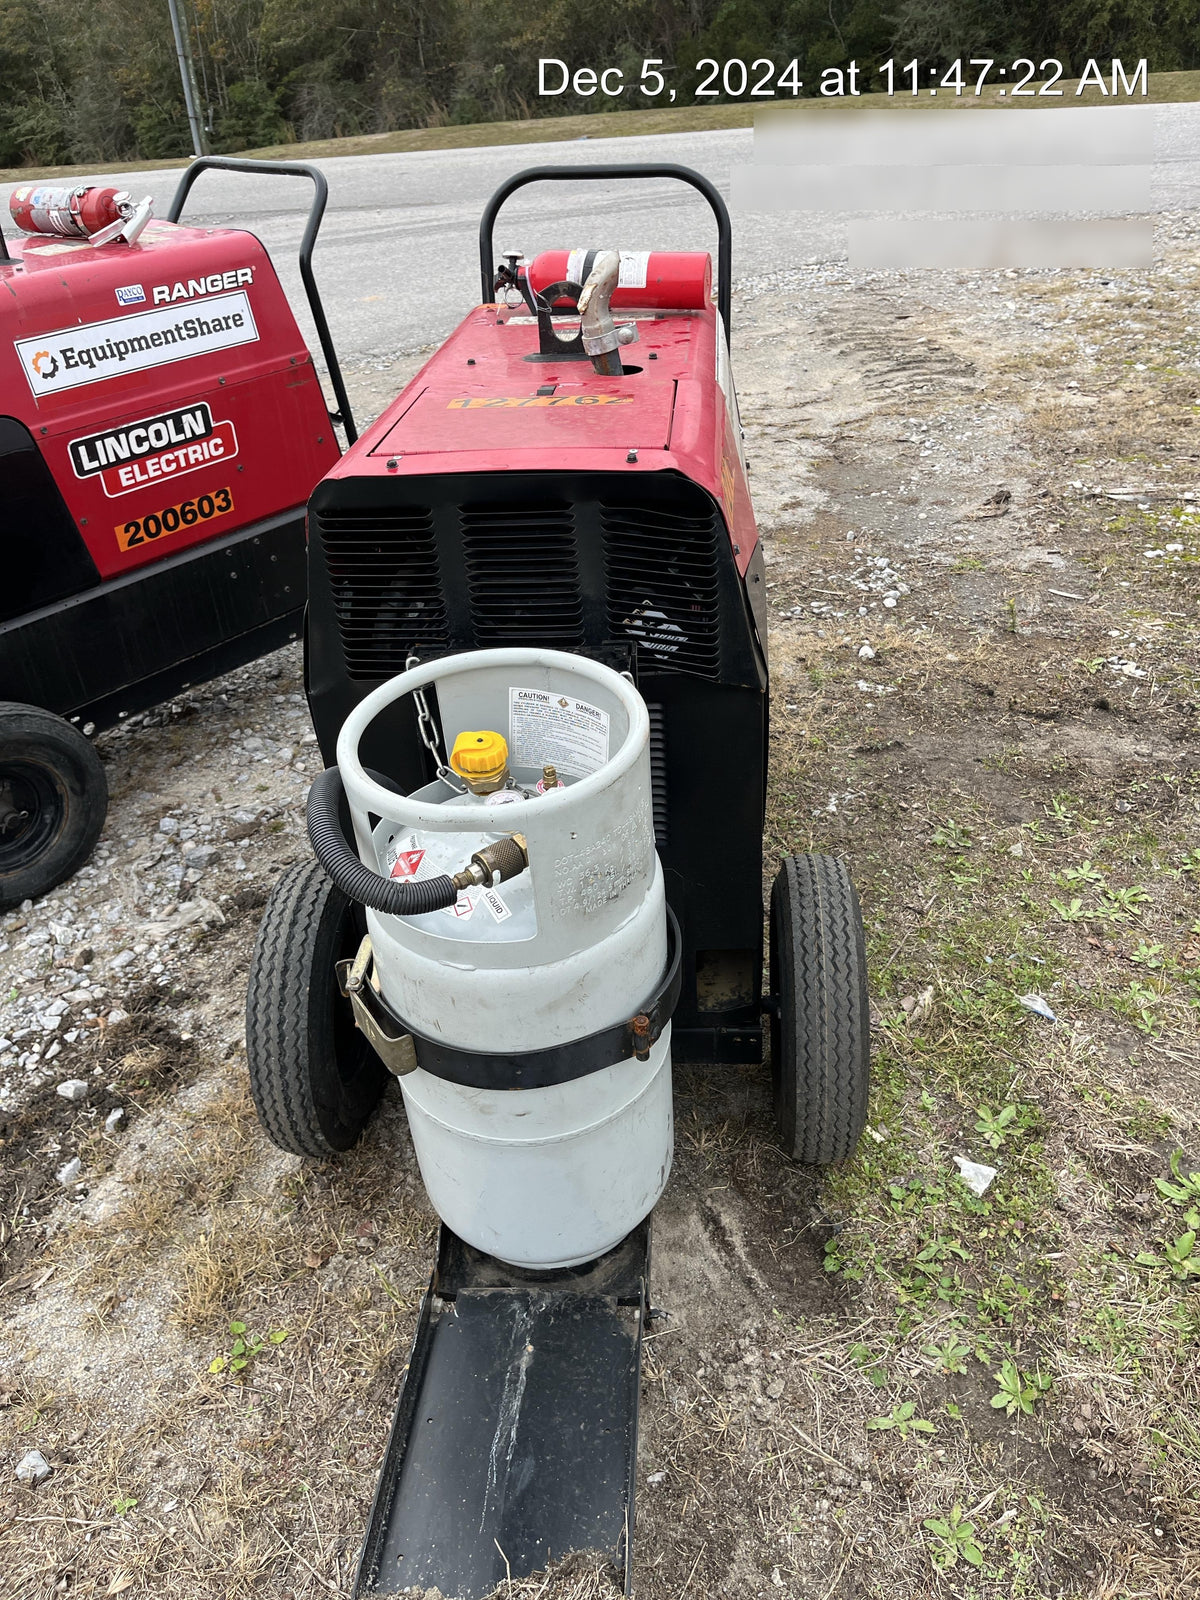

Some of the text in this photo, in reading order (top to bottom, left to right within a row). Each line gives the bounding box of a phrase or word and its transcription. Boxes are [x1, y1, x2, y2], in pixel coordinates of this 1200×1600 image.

[117, 286, 143, 302] RAYCO
[152, 267, 254, 306] RANGER
[59, 311, 245, 370] EquipmentShare
[77, 409, 207, 472] LINCOLN
[117, 436, 225, 487] ELECTRIC
[123, 488, 232, 547] 200603
[518, 691, 550, 701] CAUTION!
[575, 703, 602, 719] DANGER!
[485, 891, 503, 914] LIQUID
